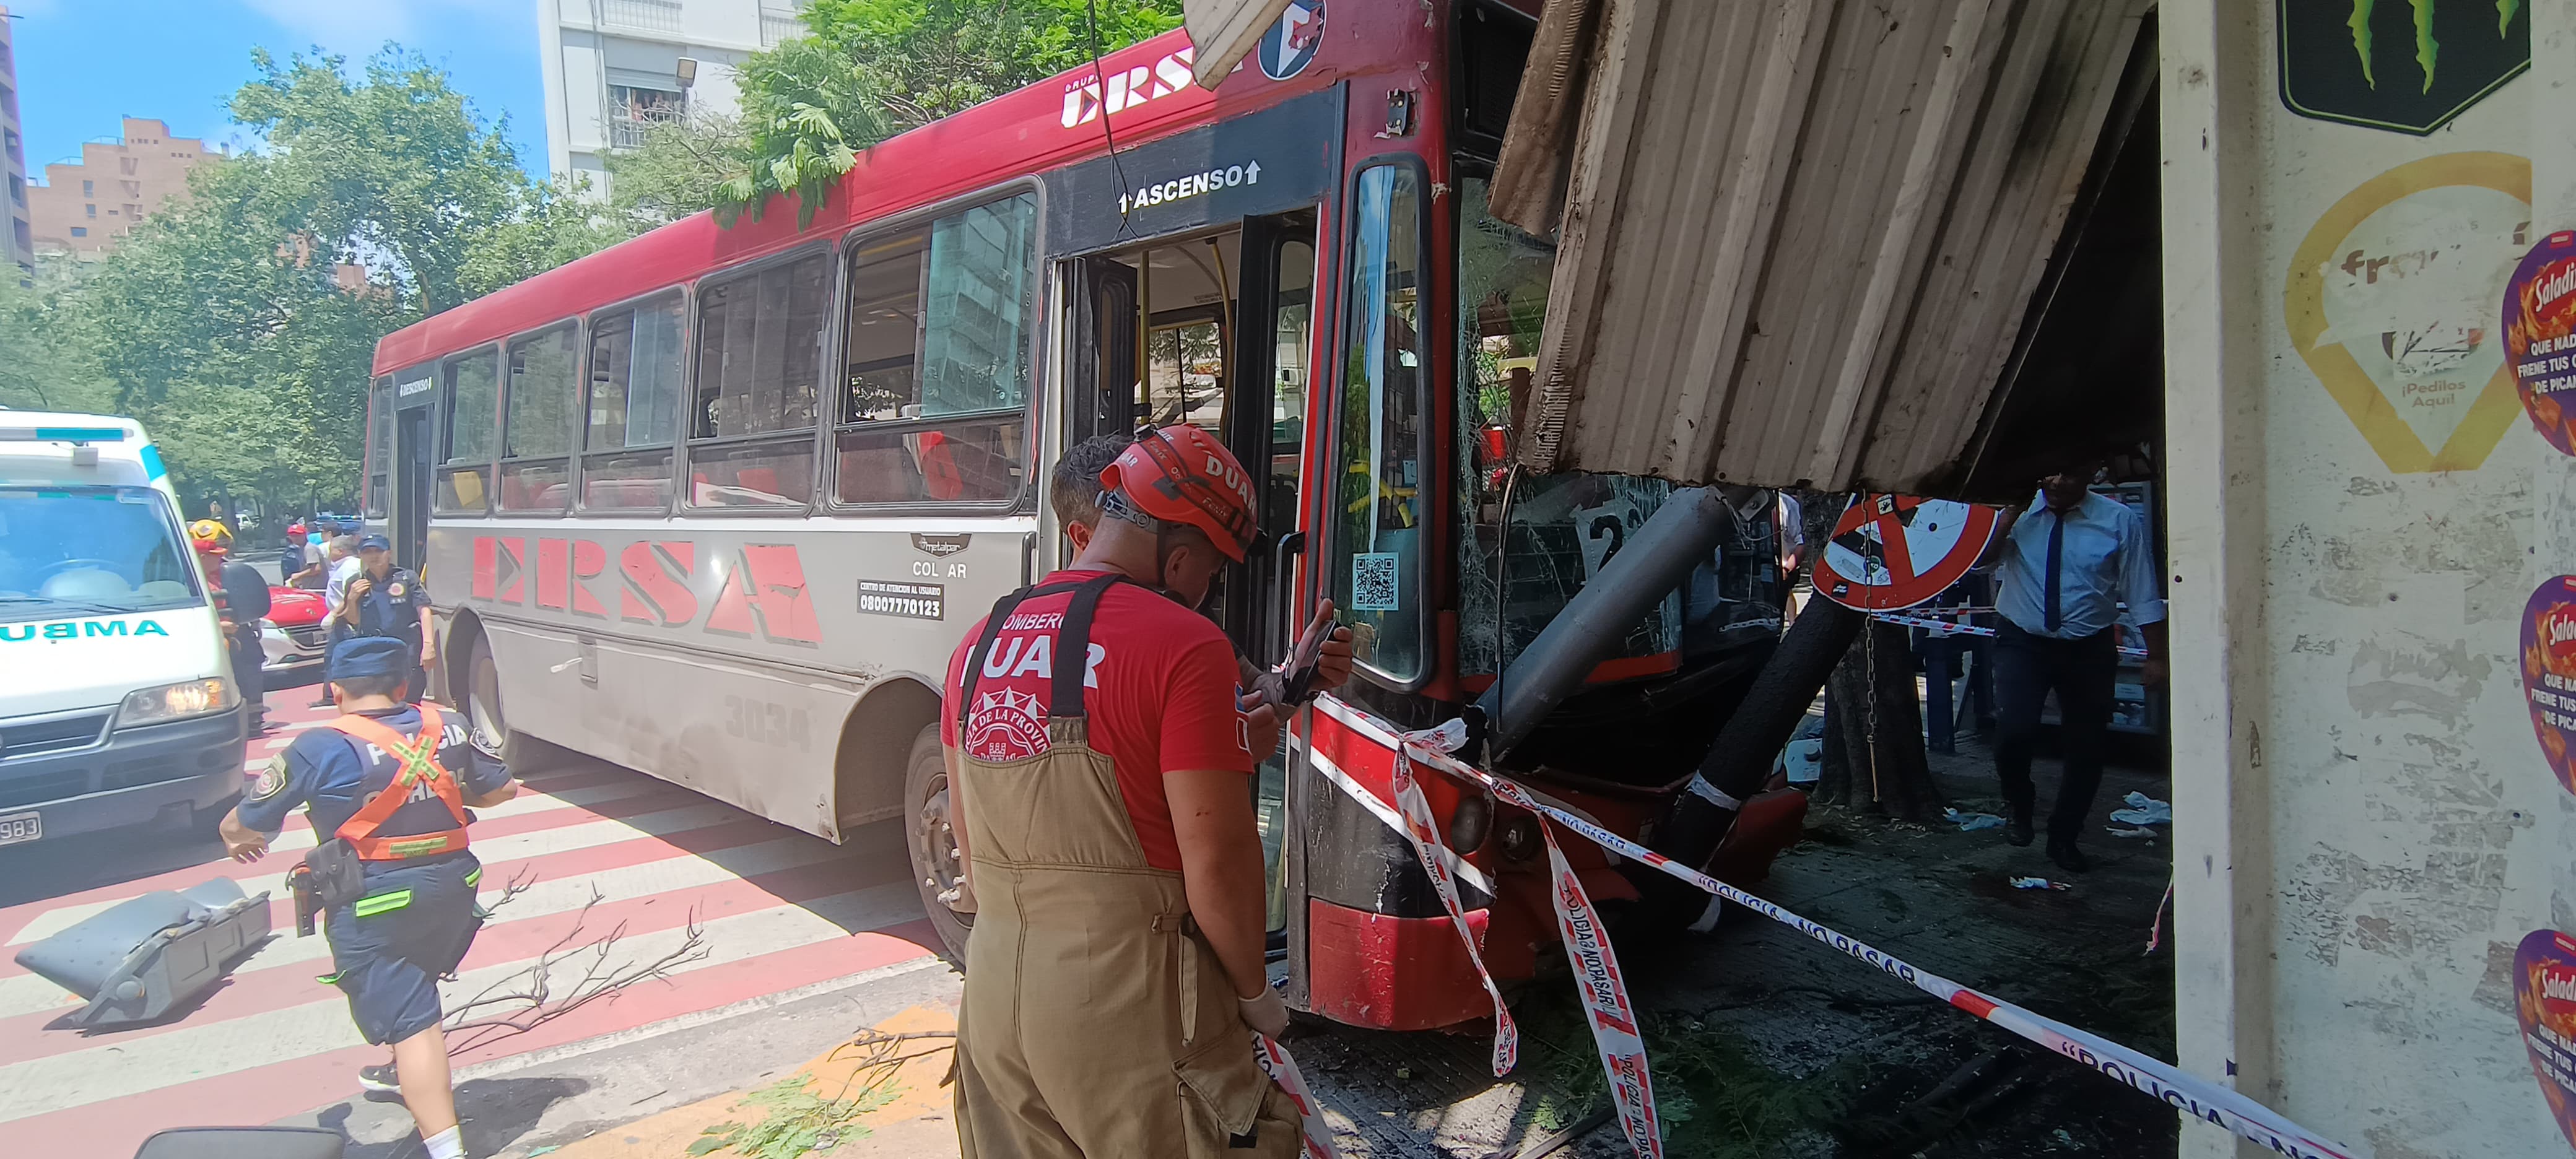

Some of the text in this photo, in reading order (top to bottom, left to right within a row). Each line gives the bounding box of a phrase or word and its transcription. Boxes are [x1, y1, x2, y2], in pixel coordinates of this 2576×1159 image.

[1133, 165, 1243, 210] ASCENSO
[2535, 261, 2576, 313] Saladi
[2530, 339, 2552, 357] QUE
[2517, 360, 2547, 379] FRENE
[2548, 355, 2569, 371] TUS
[402, 378, 429, 397] DESCENSO
[2535, 380, 2549, 395] DE
[913, 561, 967, 579] COL AR
[471, 536, 824, 645] ERSA
[859, 582, 941, 596] CENTRO DE ATENCION AL USUARIO
[859, 594, 941, 617] 08007770123
[2544, 673, 2563, 689] QUE
[2531, 688, 2557, 708] FRENE
[978, 711, 993, 726] DE
[994, 708, 1009, 721] LA
[2545, 711, 2557, 726] DE
[0, 818, 38, 840] 983
[2538, 1023, 2558, 1044] QUE
[2554, 1049, 2572, 1072] TUS
